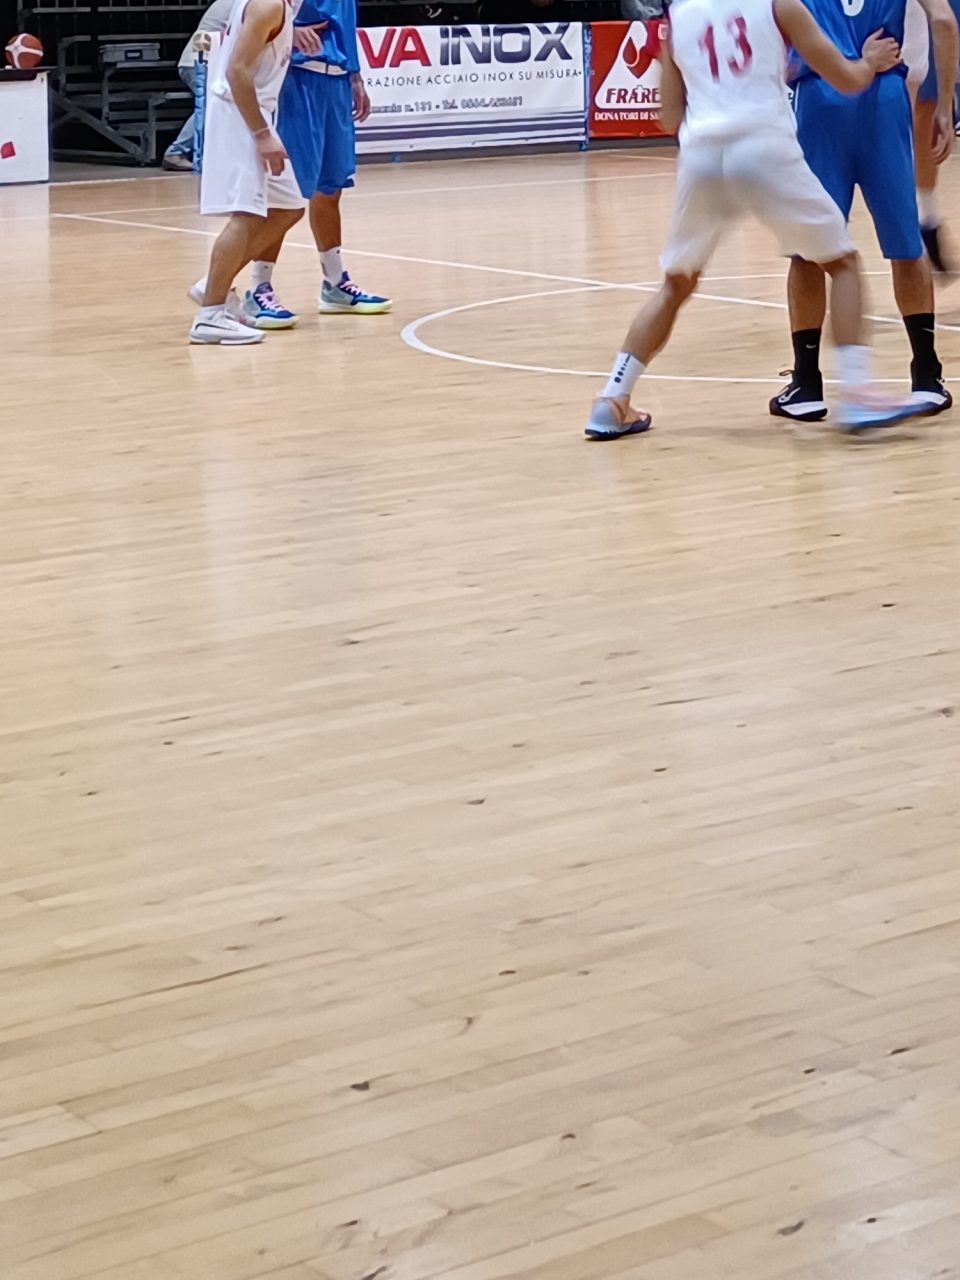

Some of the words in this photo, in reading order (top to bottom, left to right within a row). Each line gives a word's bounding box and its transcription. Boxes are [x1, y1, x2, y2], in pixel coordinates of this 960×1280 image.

[439, 24, 573, 66] INOX
[426, 72, 479, 84] ACCIAIO
[483, 70, 515, 82] INOX
[518, 69, 532, 81] SU
